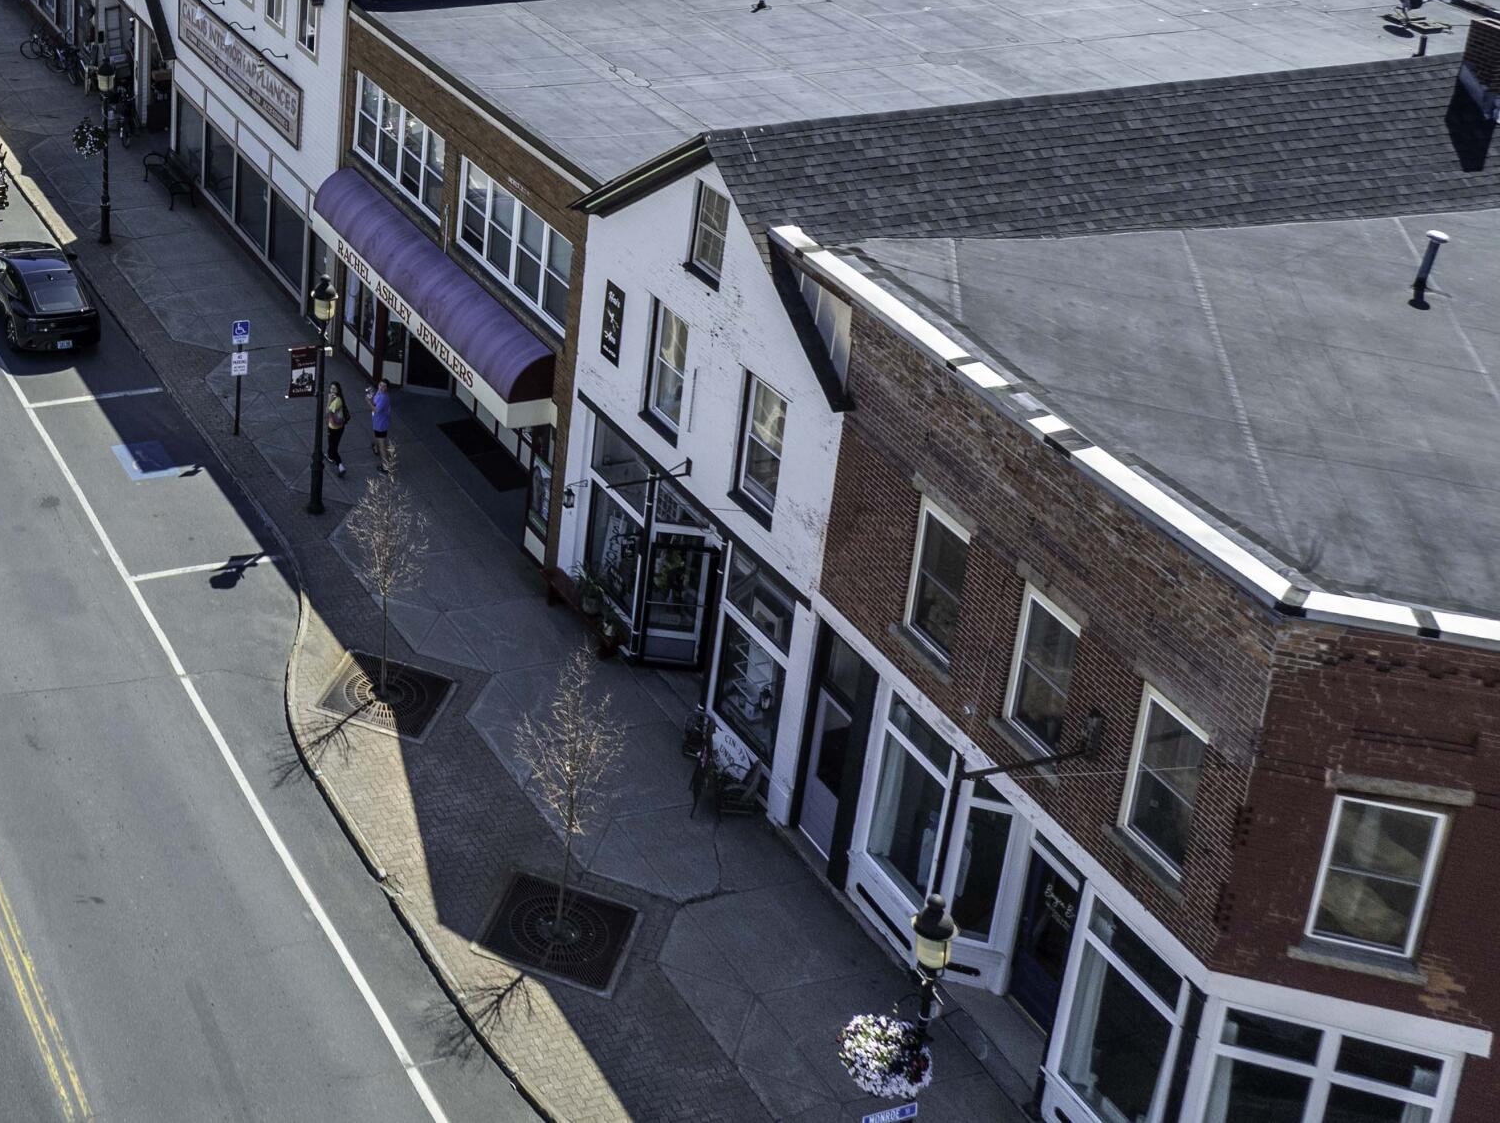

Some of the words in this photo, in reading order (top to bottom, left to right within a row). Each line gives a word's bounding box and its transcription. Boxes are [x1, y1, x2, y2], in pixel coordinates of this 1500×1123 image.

[182, 3, 208, 37] CALAIS
[209, 26, 244, 69] INTERIOR
[247, 59, 297, 116] APPLIANCES
[337, 239, 372, 285] RACHEL
[374, 281, 413, 325] ASHLEY
[416, 322, 474, 388] JEWELERS
[869, 1109, 901, 1123] MONROE
